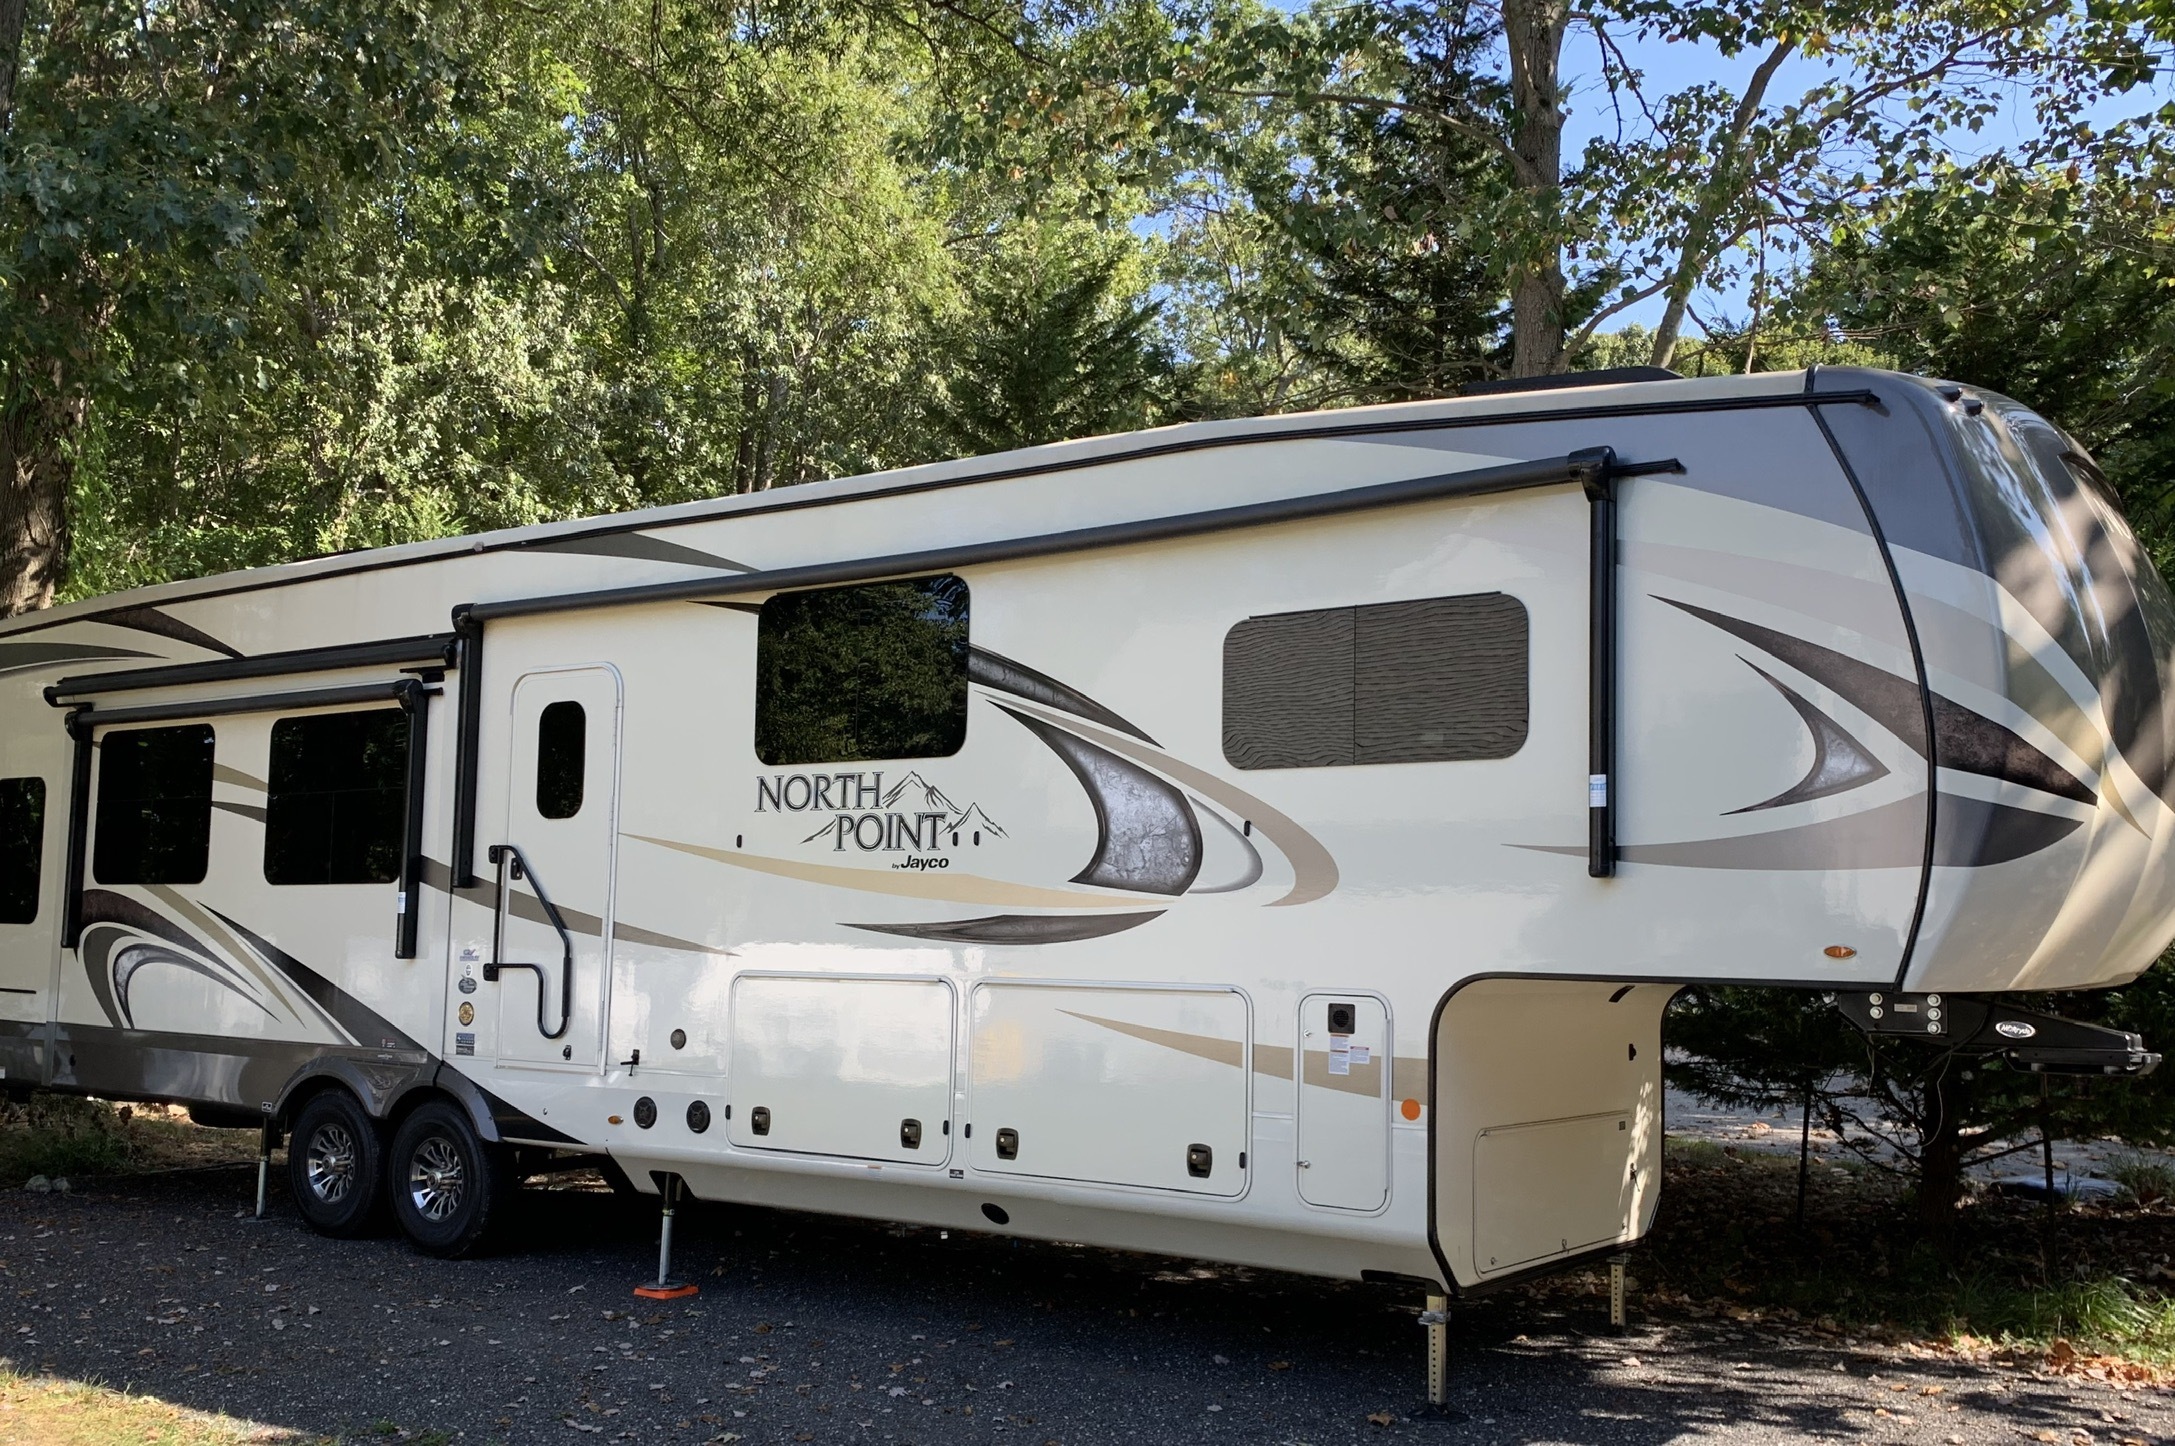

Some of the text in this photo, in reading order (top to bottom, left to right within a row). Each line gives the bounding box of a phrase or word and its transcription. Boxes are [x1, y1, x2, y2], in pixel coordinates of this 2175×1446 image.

[754, 771, 885, 813] NORTH
[833, 812, 948, 852] POINT
[901, 855, 950, 871] Jayco
